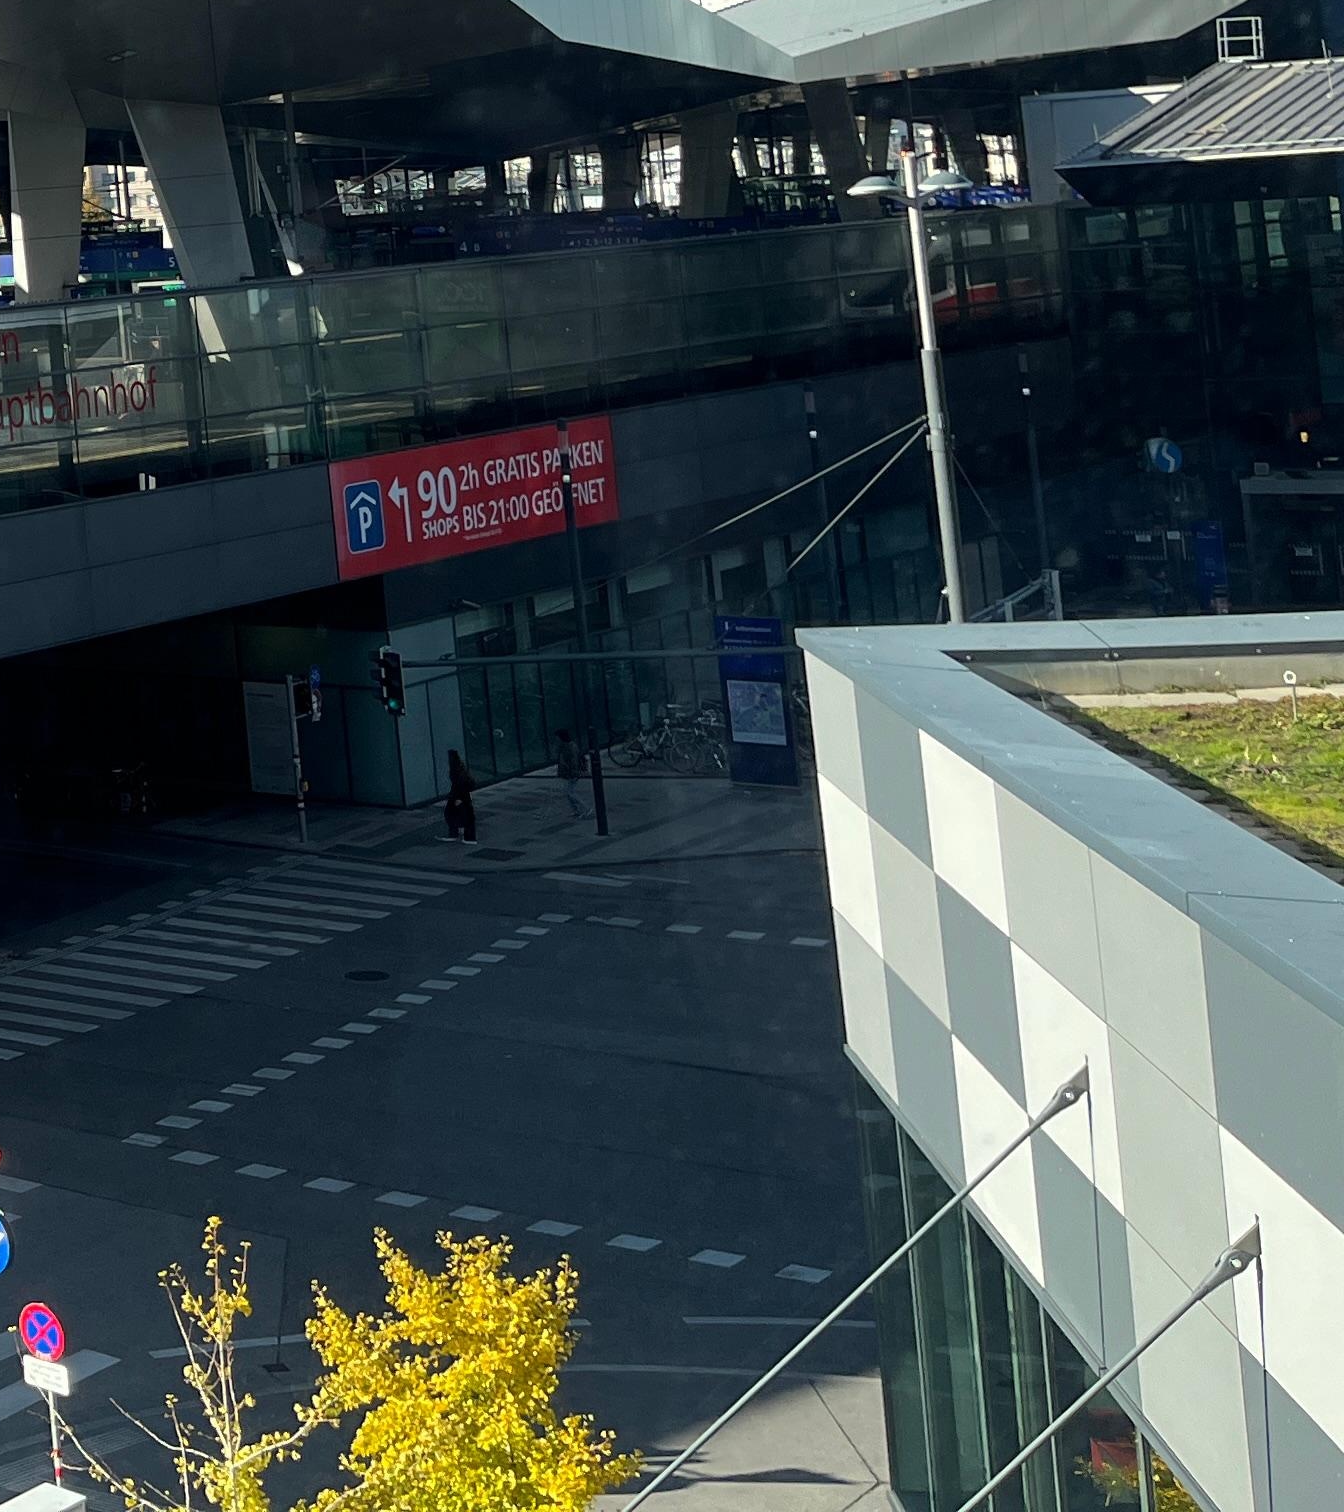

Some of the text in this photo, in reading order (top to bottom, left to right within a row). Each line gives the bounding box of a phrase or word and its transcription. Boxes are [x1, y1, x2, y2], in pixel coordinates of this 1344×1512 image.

[458, 462, 480, 491] 2h
[483, 451, 540, 486] GRATIS
[417, 466, 457, 519] 90
[462, 477, 605, 531] BIS 21:00 GEÖFNET
[358, 506, 373, 544] P
[422, 514, 460, 540] SHOPS
